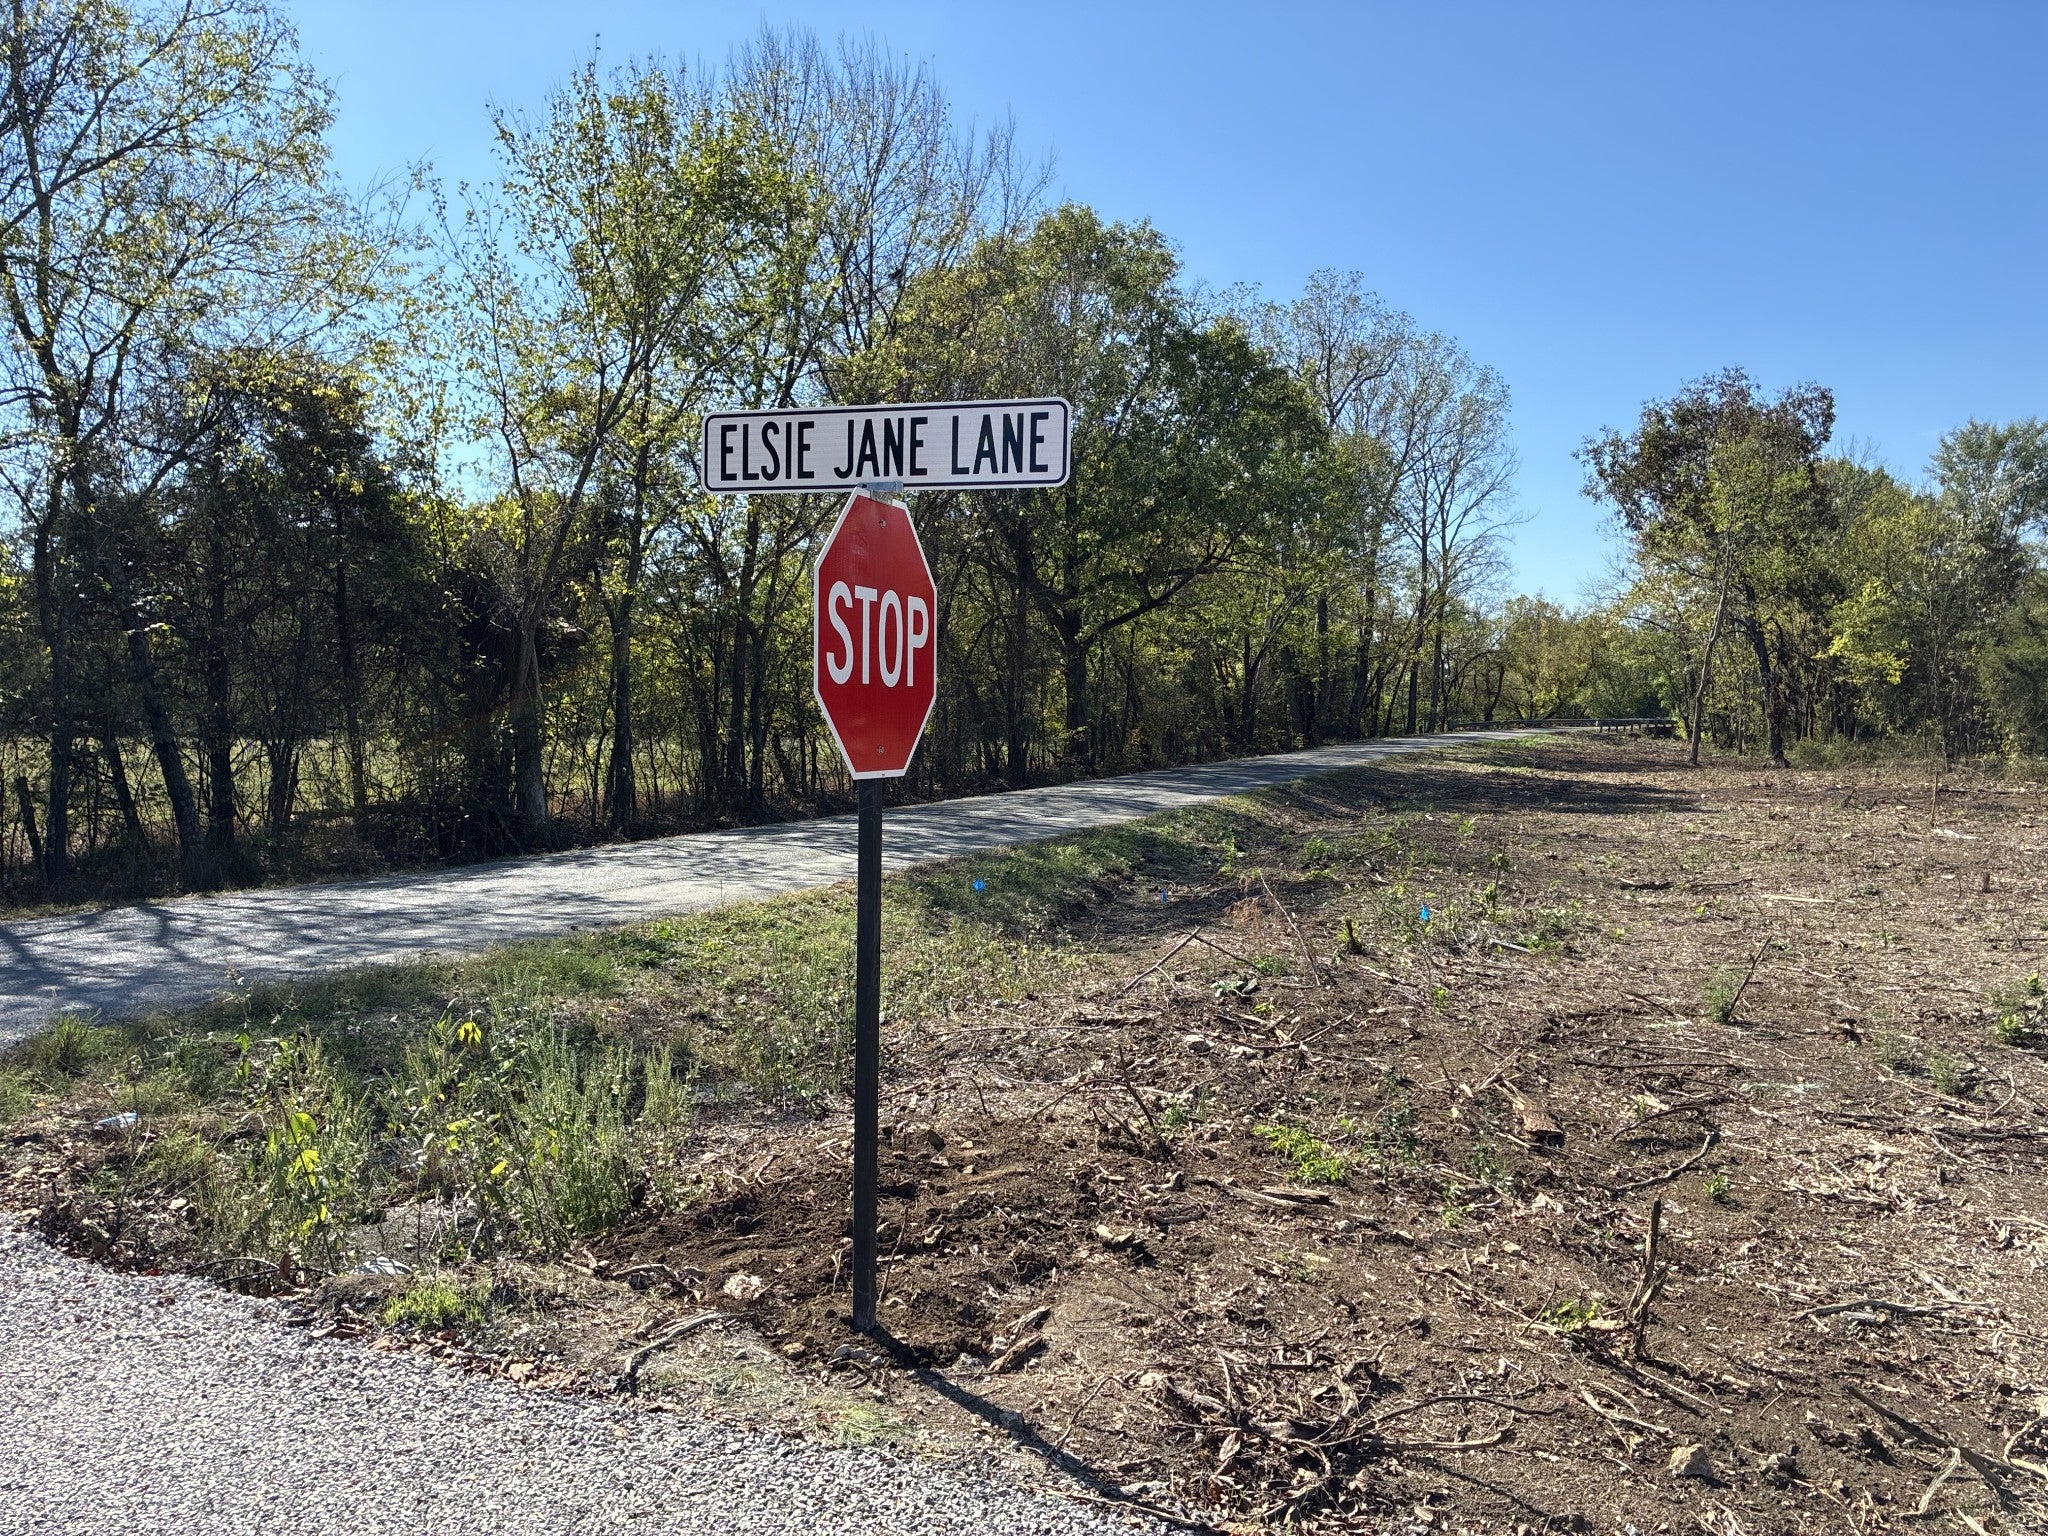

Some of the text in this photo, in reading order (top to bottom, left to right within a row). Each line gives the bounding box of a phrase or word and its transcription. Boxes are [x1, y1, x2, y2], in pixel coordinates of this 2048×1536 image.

[720, 412, 1049, 481] ELSIE JANE LANE
[826, 581, 929, 687] STOP
